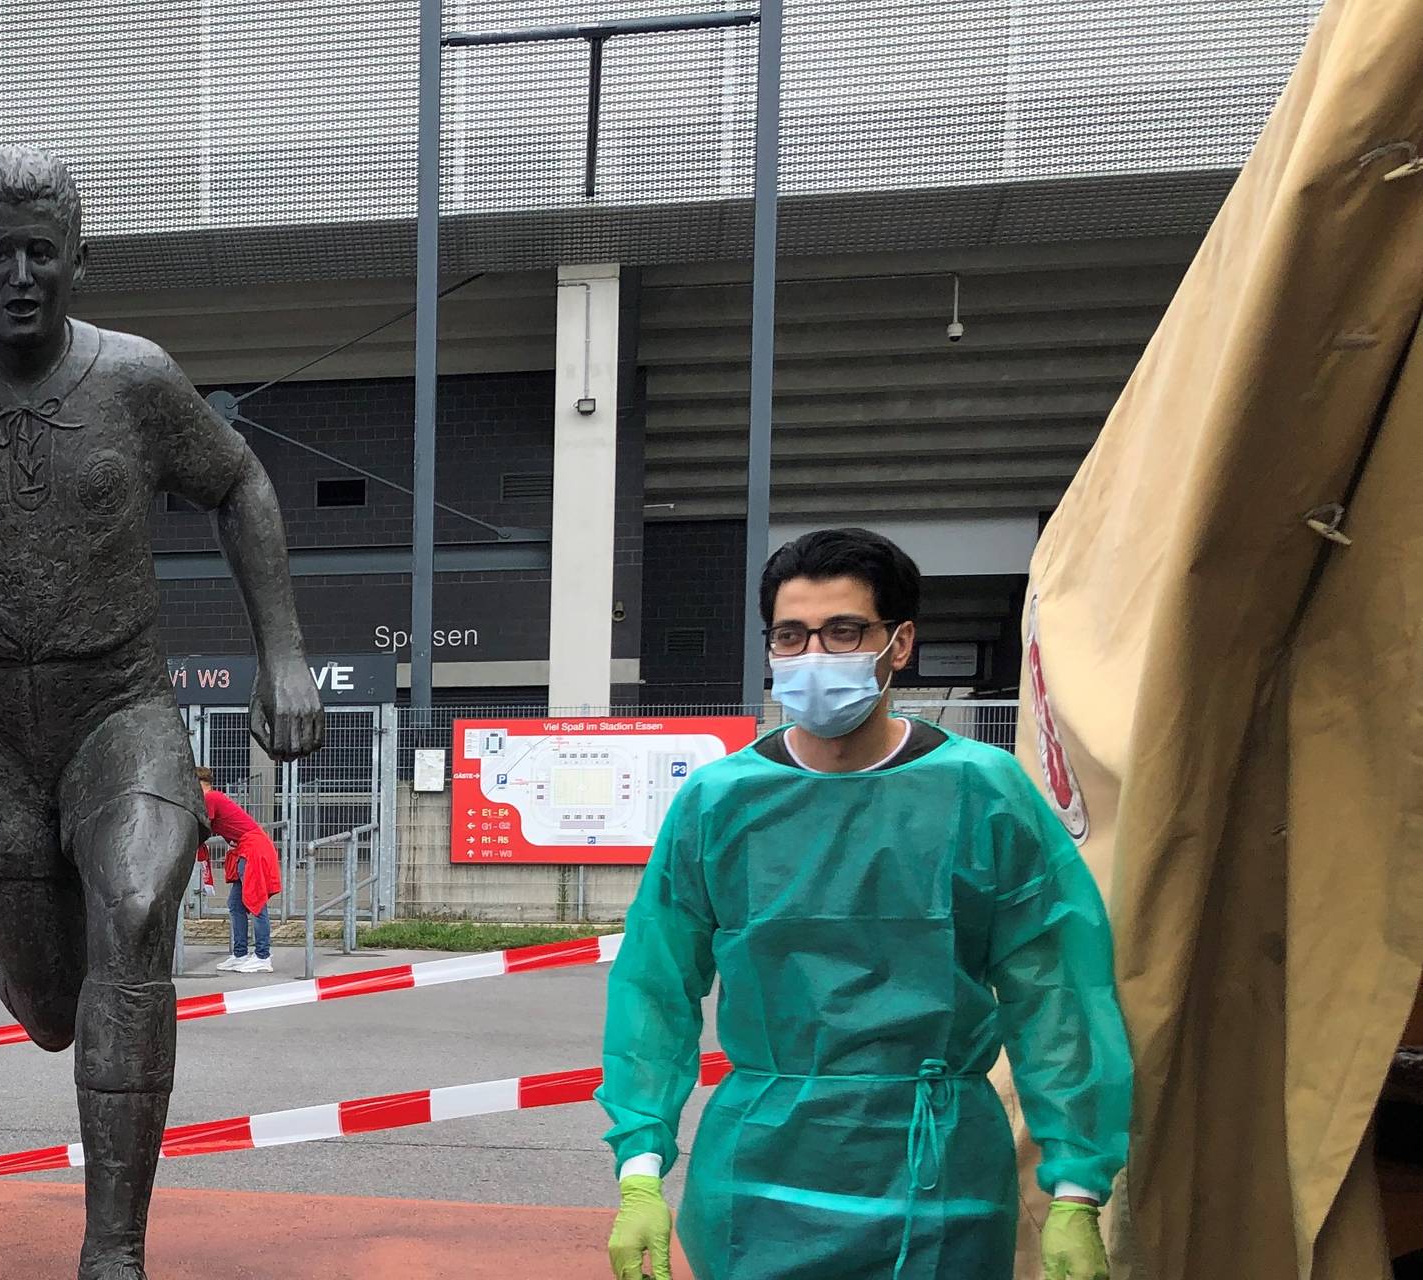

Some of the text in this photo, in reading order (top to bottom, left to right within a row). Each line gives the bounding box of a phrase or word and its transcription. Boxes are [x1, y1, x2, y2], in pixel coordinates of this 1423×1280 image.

[374, 625, 478, 653] Spsen
[197, 669, 230, 688] W3
[543, 722, 559, 731] Viel
[561, 722, 584, 732] Spaß
[599, 722, 633, 730] Stadion
[635, 721, 663, 730] Essen
[672, 765, 687, 774] P3
[498, 775, 506, 783] P
[481, 808, 491, 817] E1
